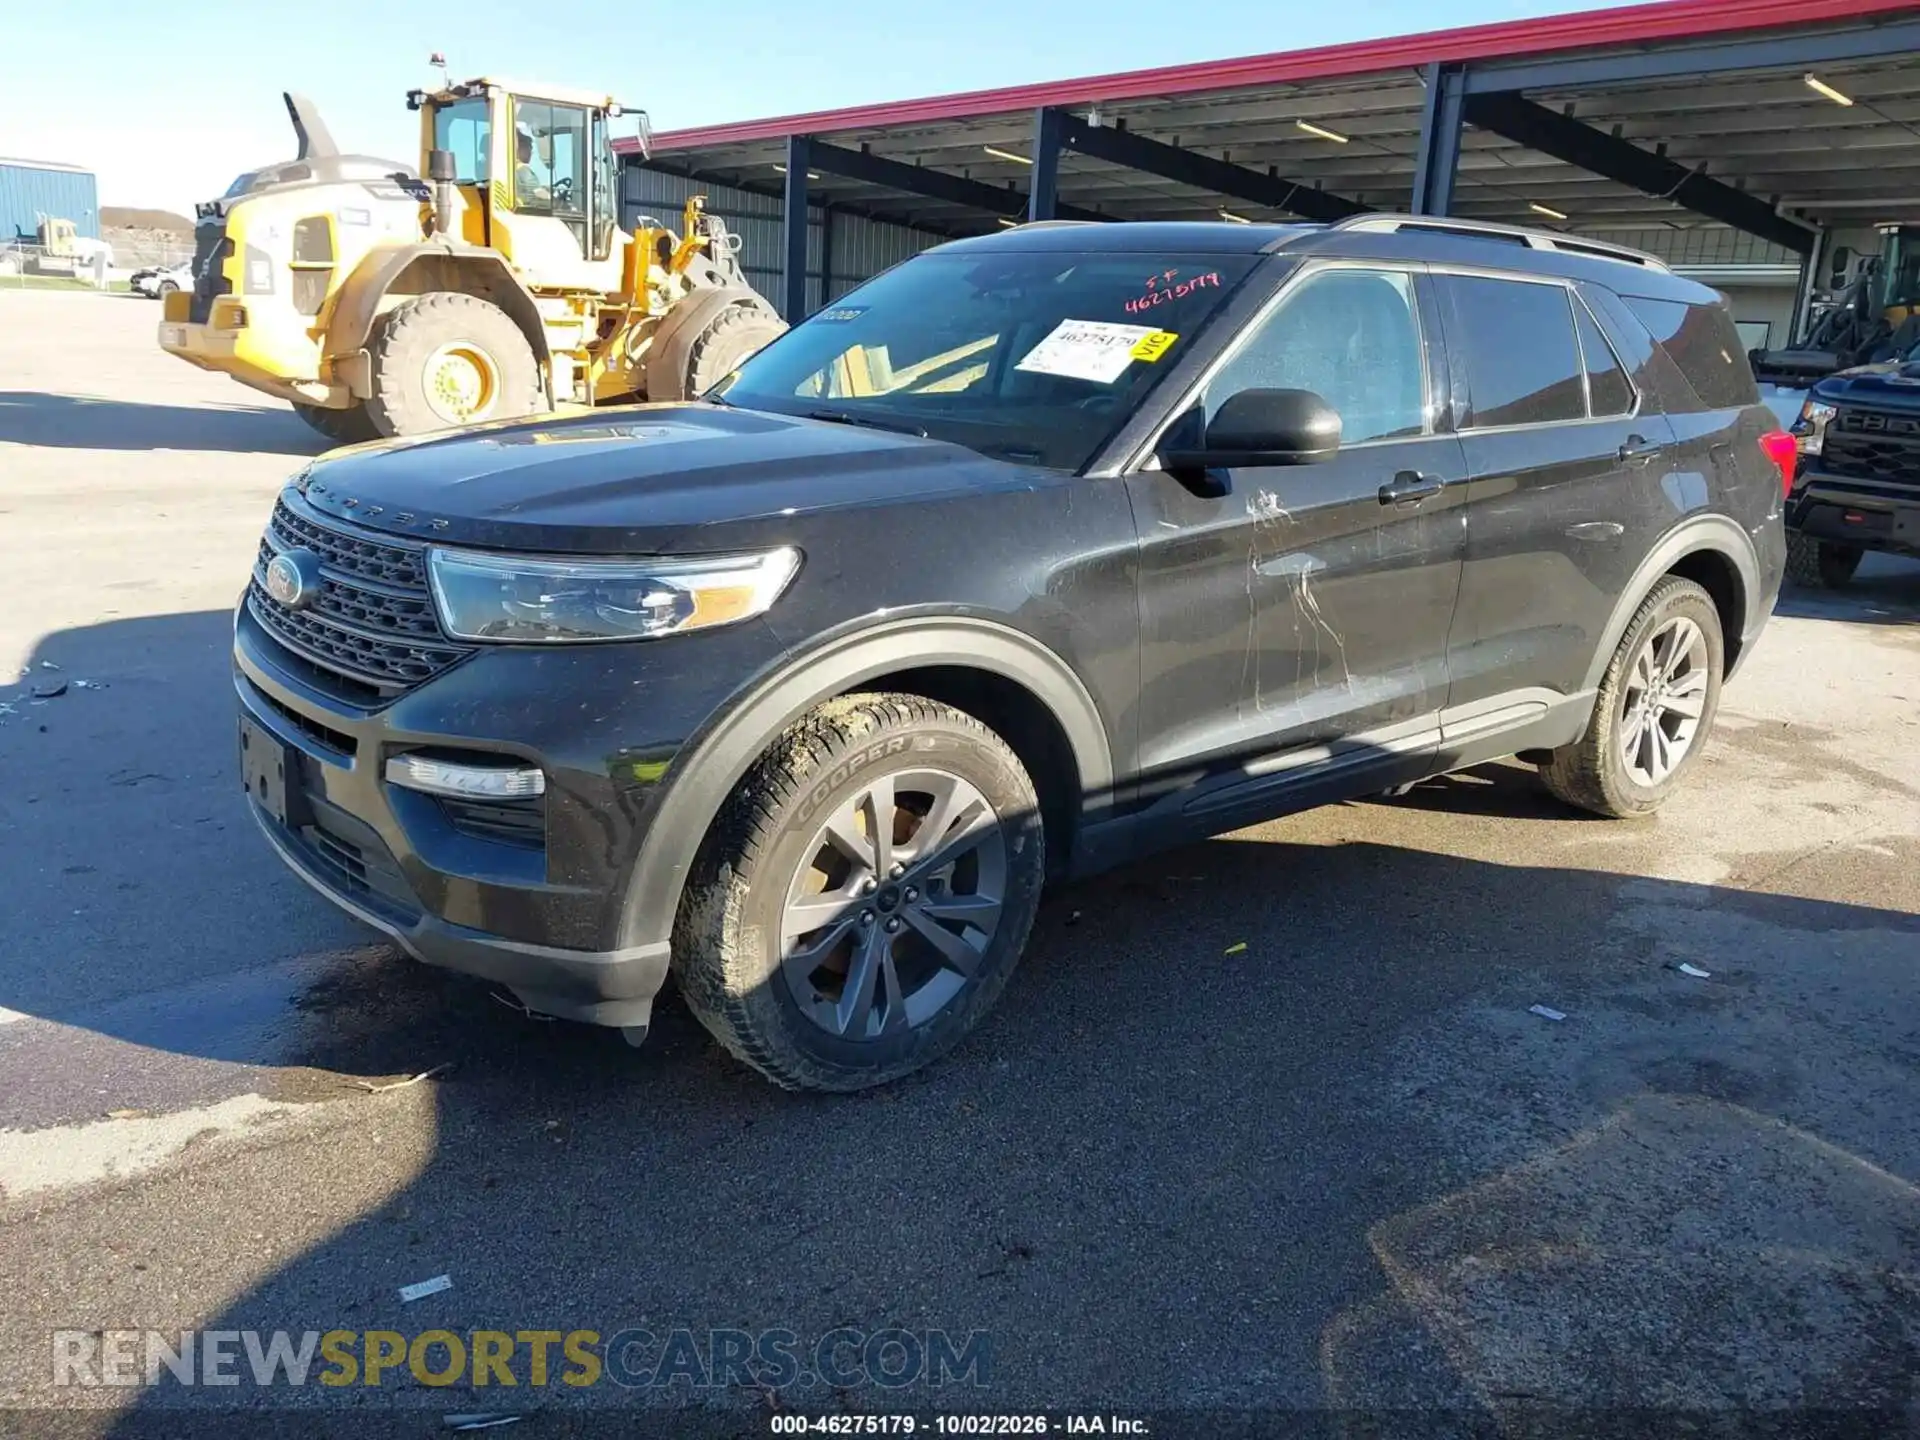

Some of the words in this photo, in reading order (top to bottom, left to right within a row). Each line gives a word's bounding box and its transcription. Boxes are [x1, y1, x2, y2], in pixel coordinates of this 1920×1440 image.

[1057, 330, 1137, 348] 46275179
[1136, 333, 1169, 358] VIC
[798, 735, 905, 822] COOPER
